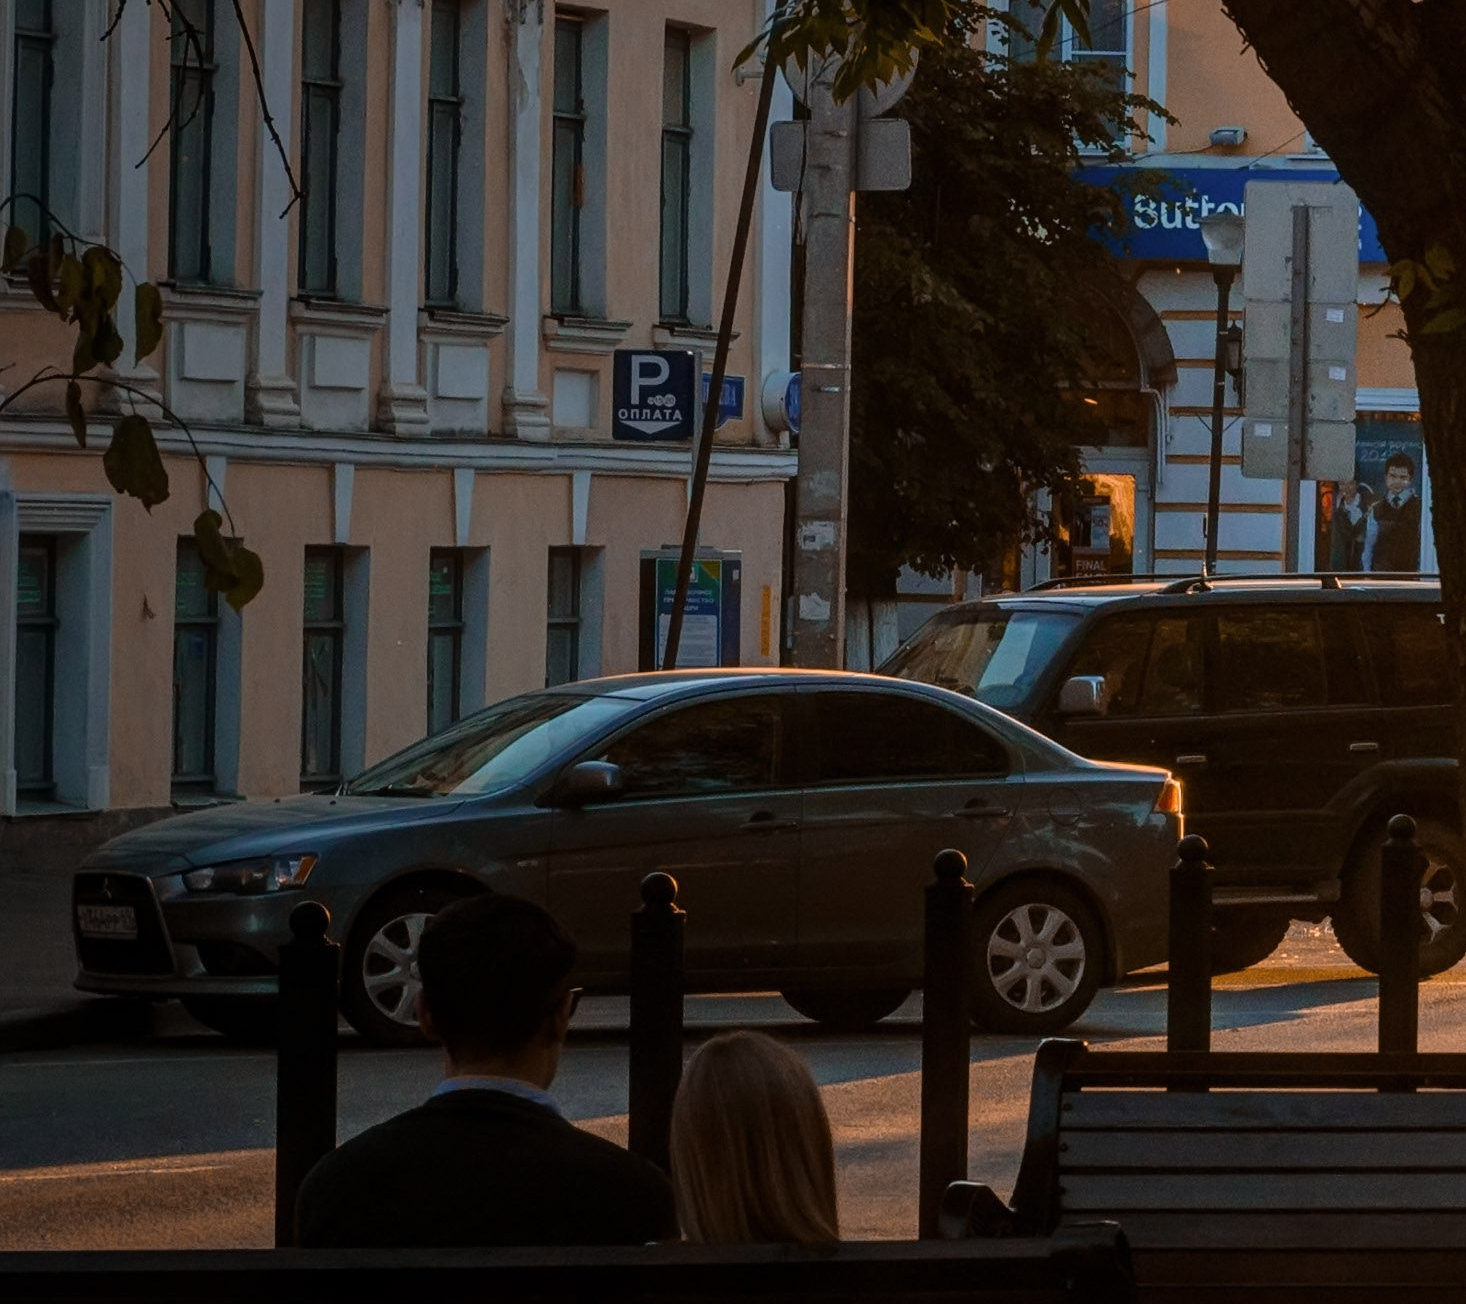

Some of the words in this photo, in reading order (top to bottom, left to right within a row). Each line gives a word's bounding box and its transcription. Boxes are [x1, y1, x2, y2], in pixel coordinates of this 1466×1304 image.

[1134, 193, 1245, 229] Butt
[618, 408, 683, 421] ОПЛАТА
[1075, 559, 1107, 571] FINAL
